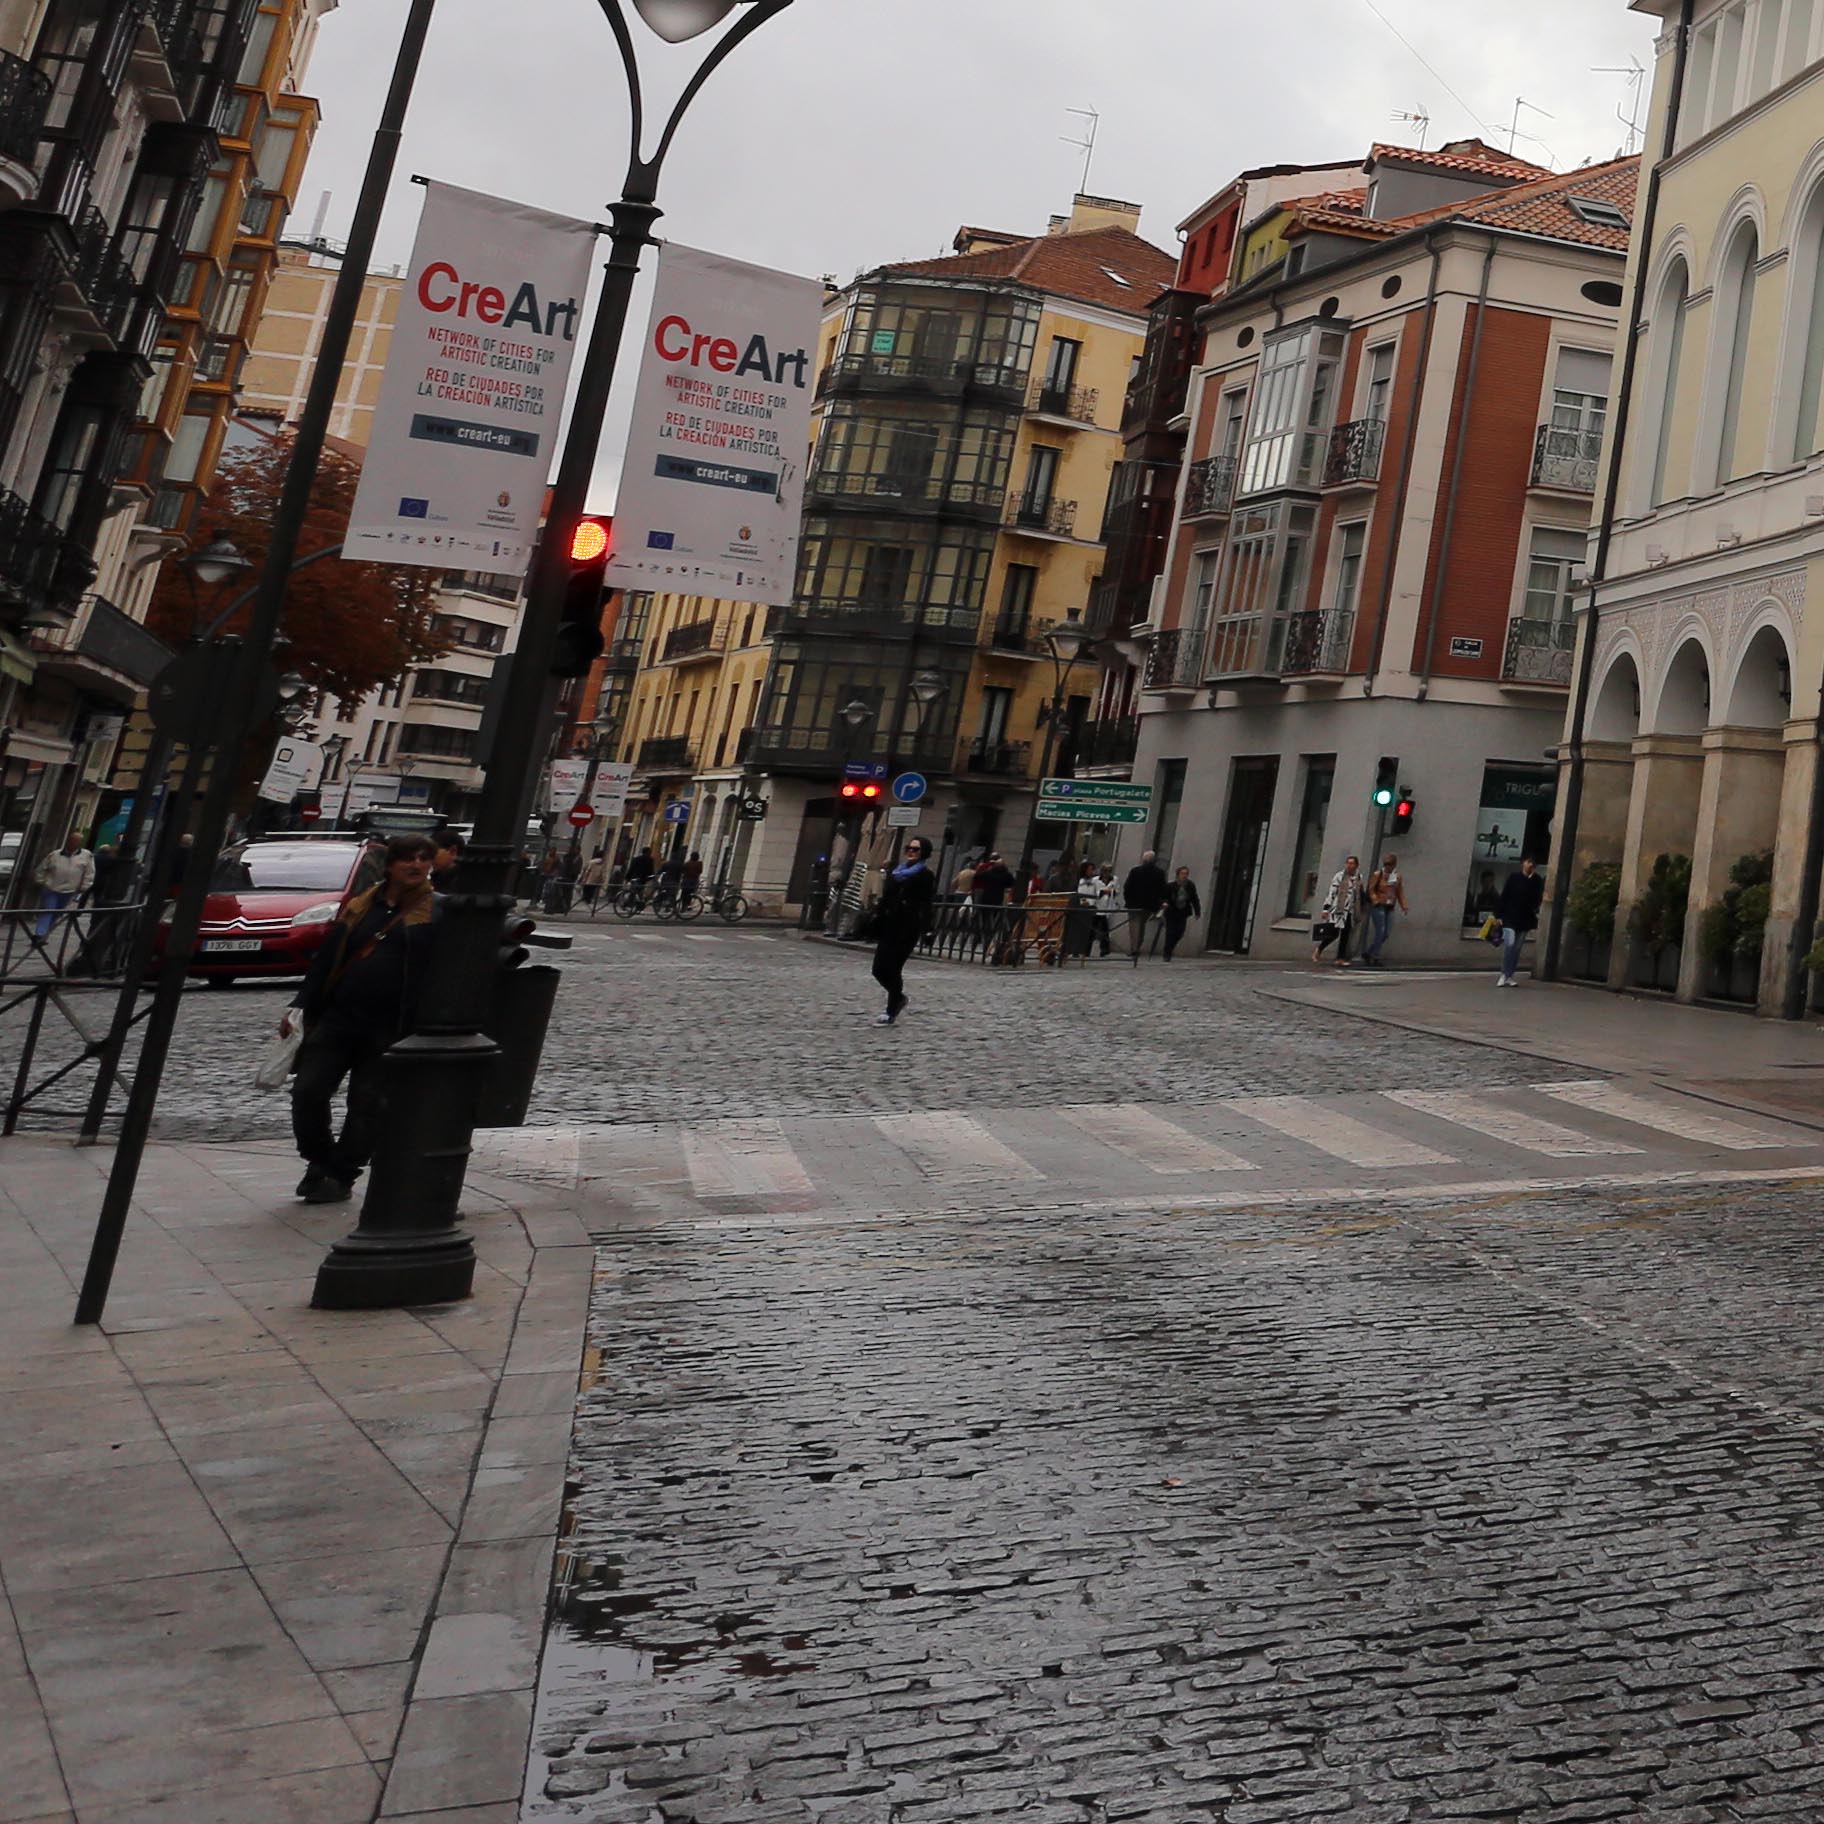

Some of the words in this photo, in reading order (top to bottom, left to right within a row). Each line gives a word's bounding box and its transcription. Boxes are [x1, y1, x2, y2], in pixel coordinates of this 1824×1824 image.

[417, 261, 578, 341] CreArt
[428, 327, 480, 350] NETWORK
[483, 338, 496, 351] OF
[499, 341, 533, 359] CITIES
[536, 348, 555, 364] FOR
[440, 345, 487, 366] ARTISTIC
[490, 355, 541, 376] CREATION
[655, 314, 808, 389] CreArt
[417, 382, 433, 397] LA
[425, 367, 448, 383] RED
[451, 372, 466, 386] DE
[468, 375, 522, 398] CIUDADES
[524, 385, 544, 401] POR
[666, 375, 713, 395] NETWORK
[717, 385, 730, 397] OF
[732, 389, 764, 405] CITIES
[768, 395, 787, 408] FOR
[677, 392, 721, 410] ARTISTIC
[725, 401, 773, 420] CREATION
[660, 425, 672, 438] LA
[666, 412, 685, 426] RED
[689, 416, 701, 429] DE
[705, 420, 755, 440] CIUDADES
[759, 429, 778, 442] POR
